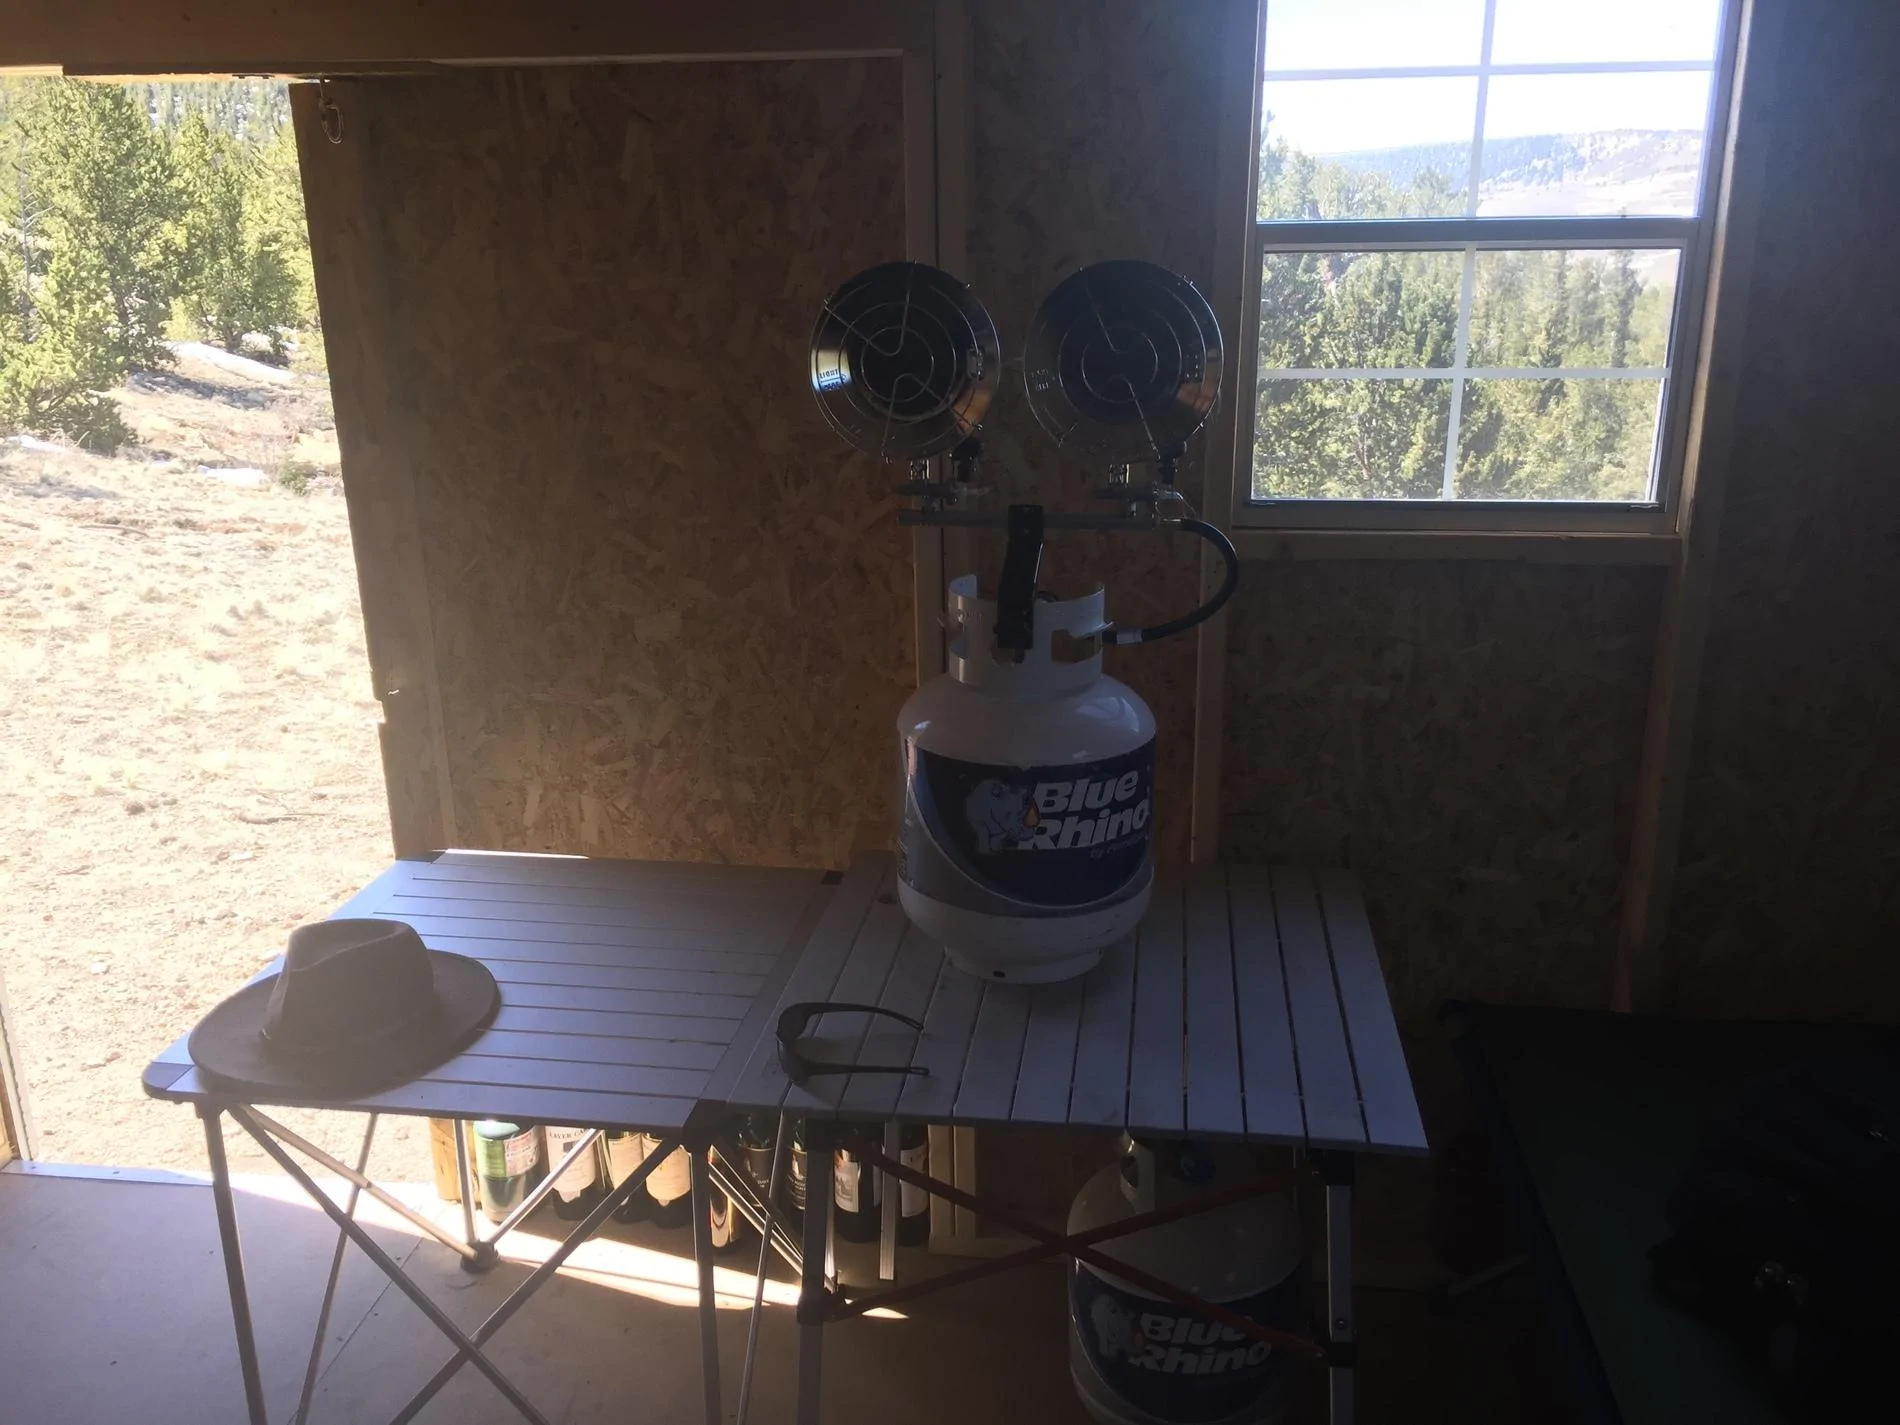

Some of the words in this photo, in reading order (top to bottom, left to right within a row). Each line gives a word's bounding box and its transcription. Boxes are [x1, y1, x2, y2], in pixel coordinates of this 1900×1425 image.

[819, 368, 839, 379] LIGHT
[1033, 769, 1139, 814] Blue
[1016, 798, 1150, 850] Rhino
[1127, 1341, 1273, 1375] Rhino
